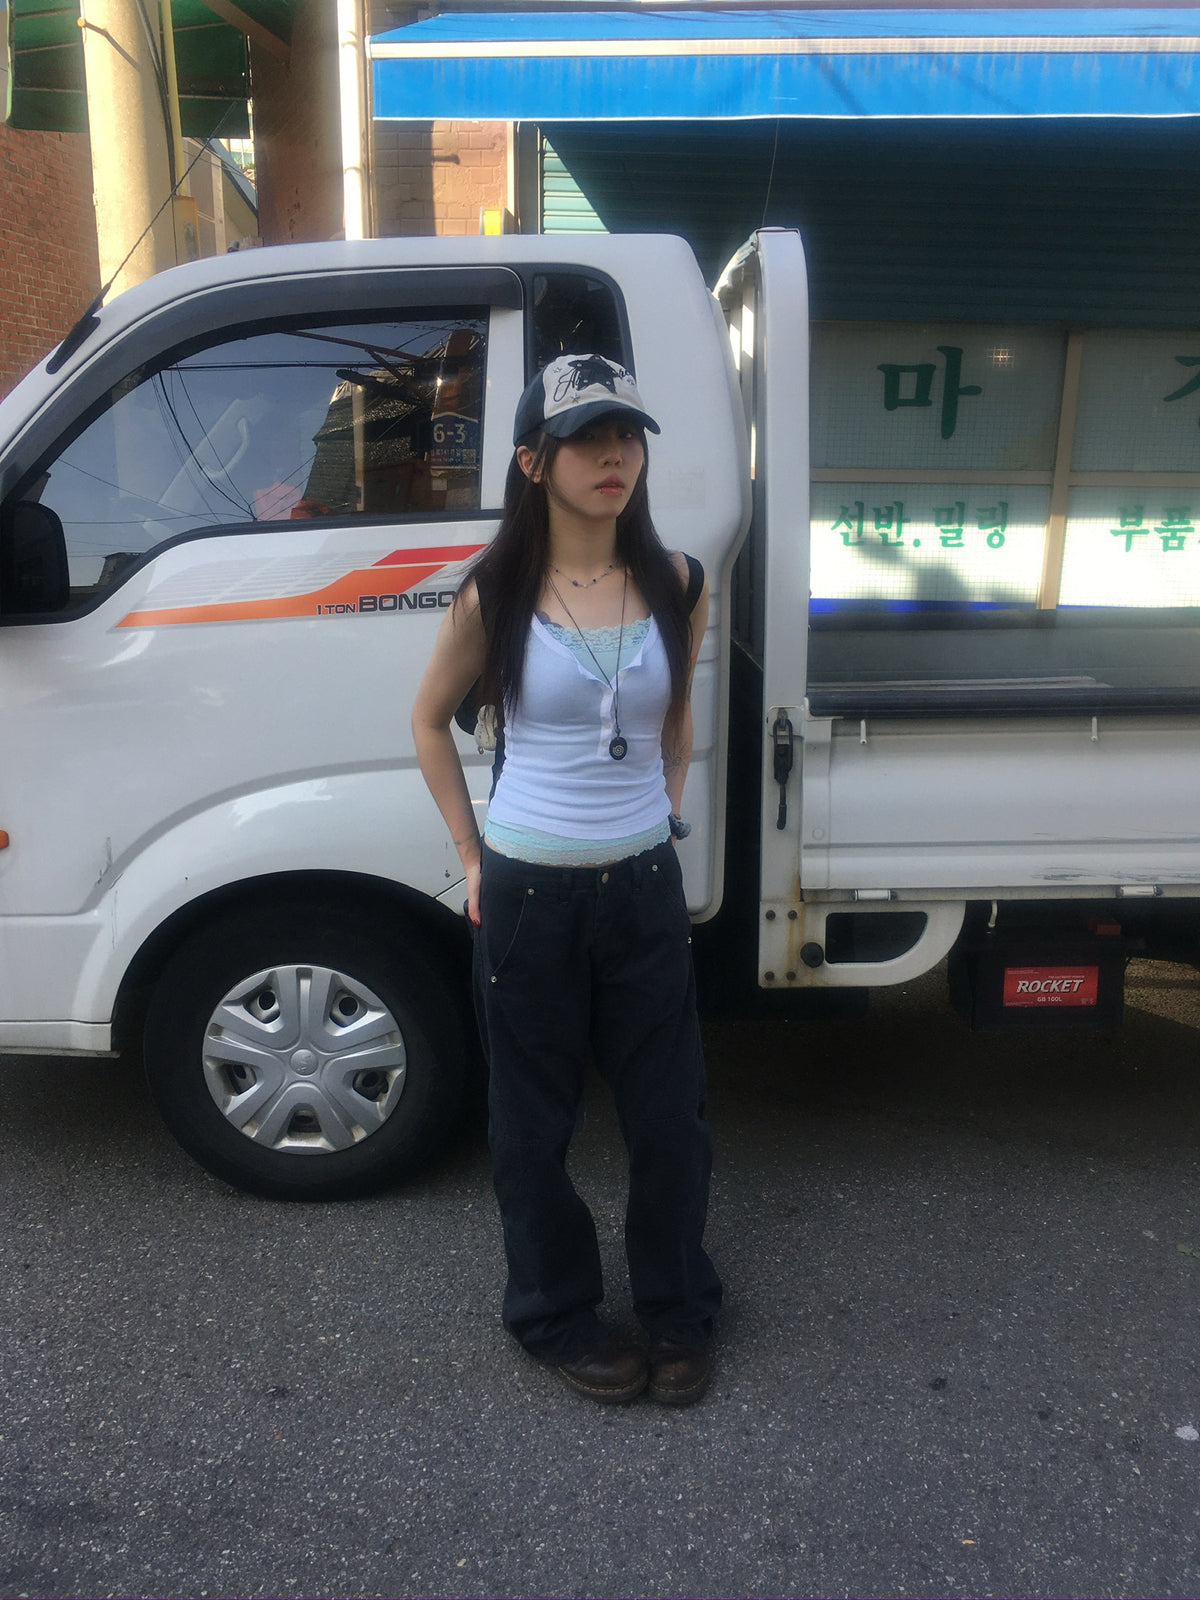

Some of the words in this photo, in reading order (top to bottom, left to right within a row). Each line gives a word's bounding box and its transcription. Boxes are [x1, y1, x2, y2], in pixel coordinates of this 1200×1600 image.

[877, 346, 982, 440] 마
[433, 423, 466, 444] 6-3
[1110, 504, 1200, 553] 부품
[325, 603, 356, 615] TON
[359, 590, 456, 613] BONGO
[1016, 979, 1084, 993] ROCKET
